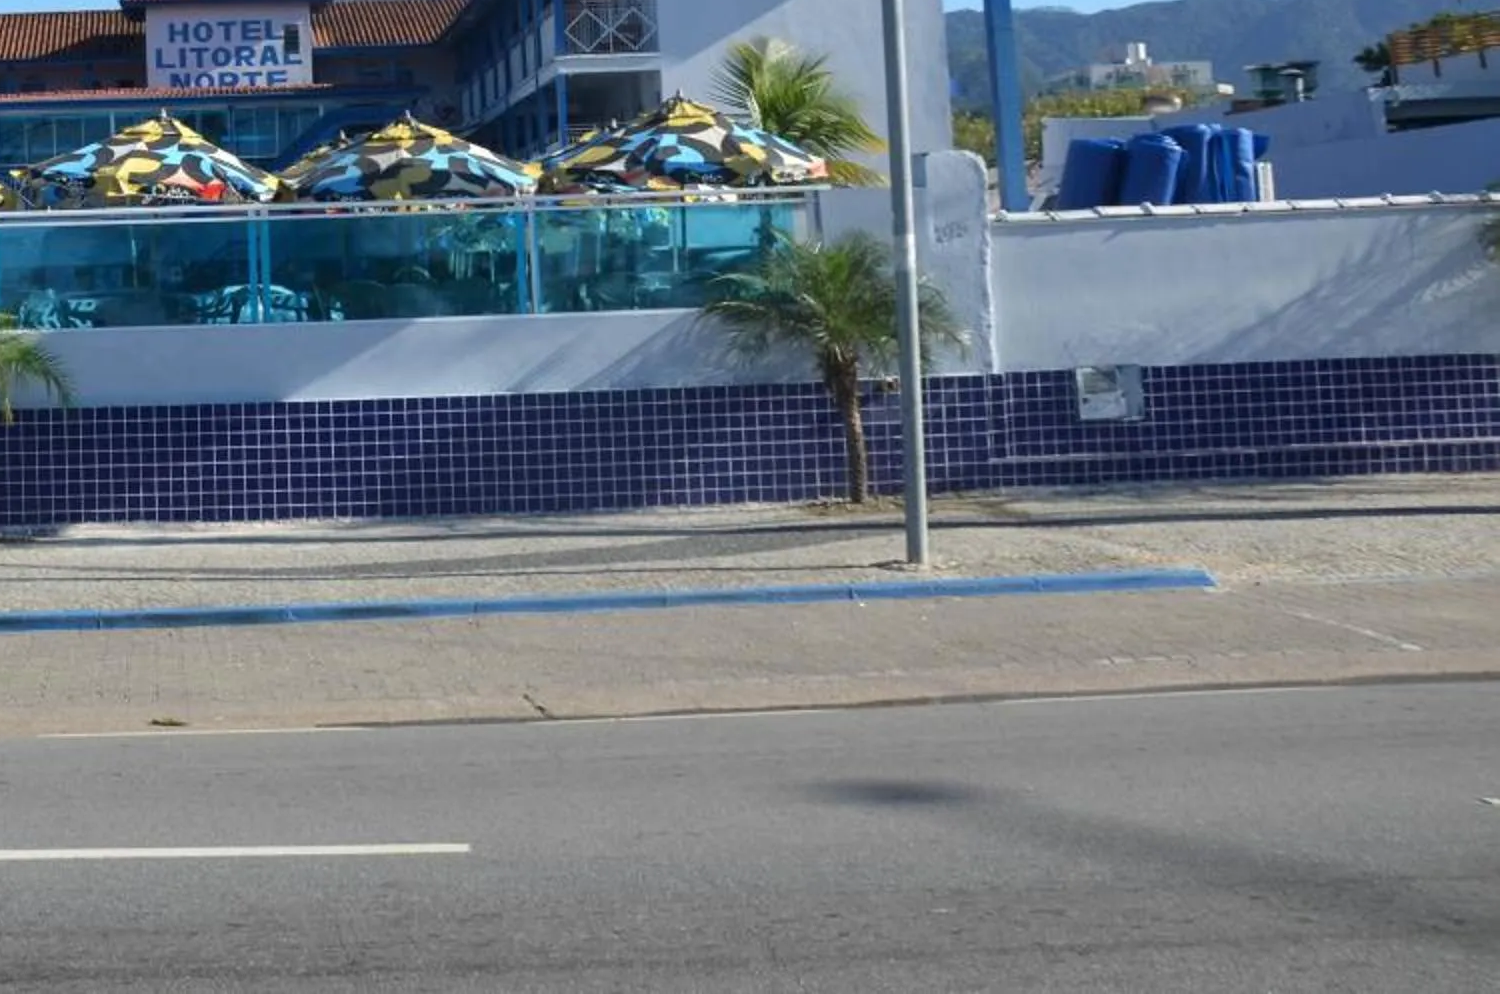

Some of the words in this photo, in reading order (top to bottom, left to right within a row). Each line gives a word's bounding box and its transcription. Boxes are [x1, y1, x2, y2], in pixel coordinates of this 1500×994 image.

[168, 19, 284, 44] HOTEL
[155, 45, 304, 69] LITORAL
[169, 70, 288, 89] NORTE
